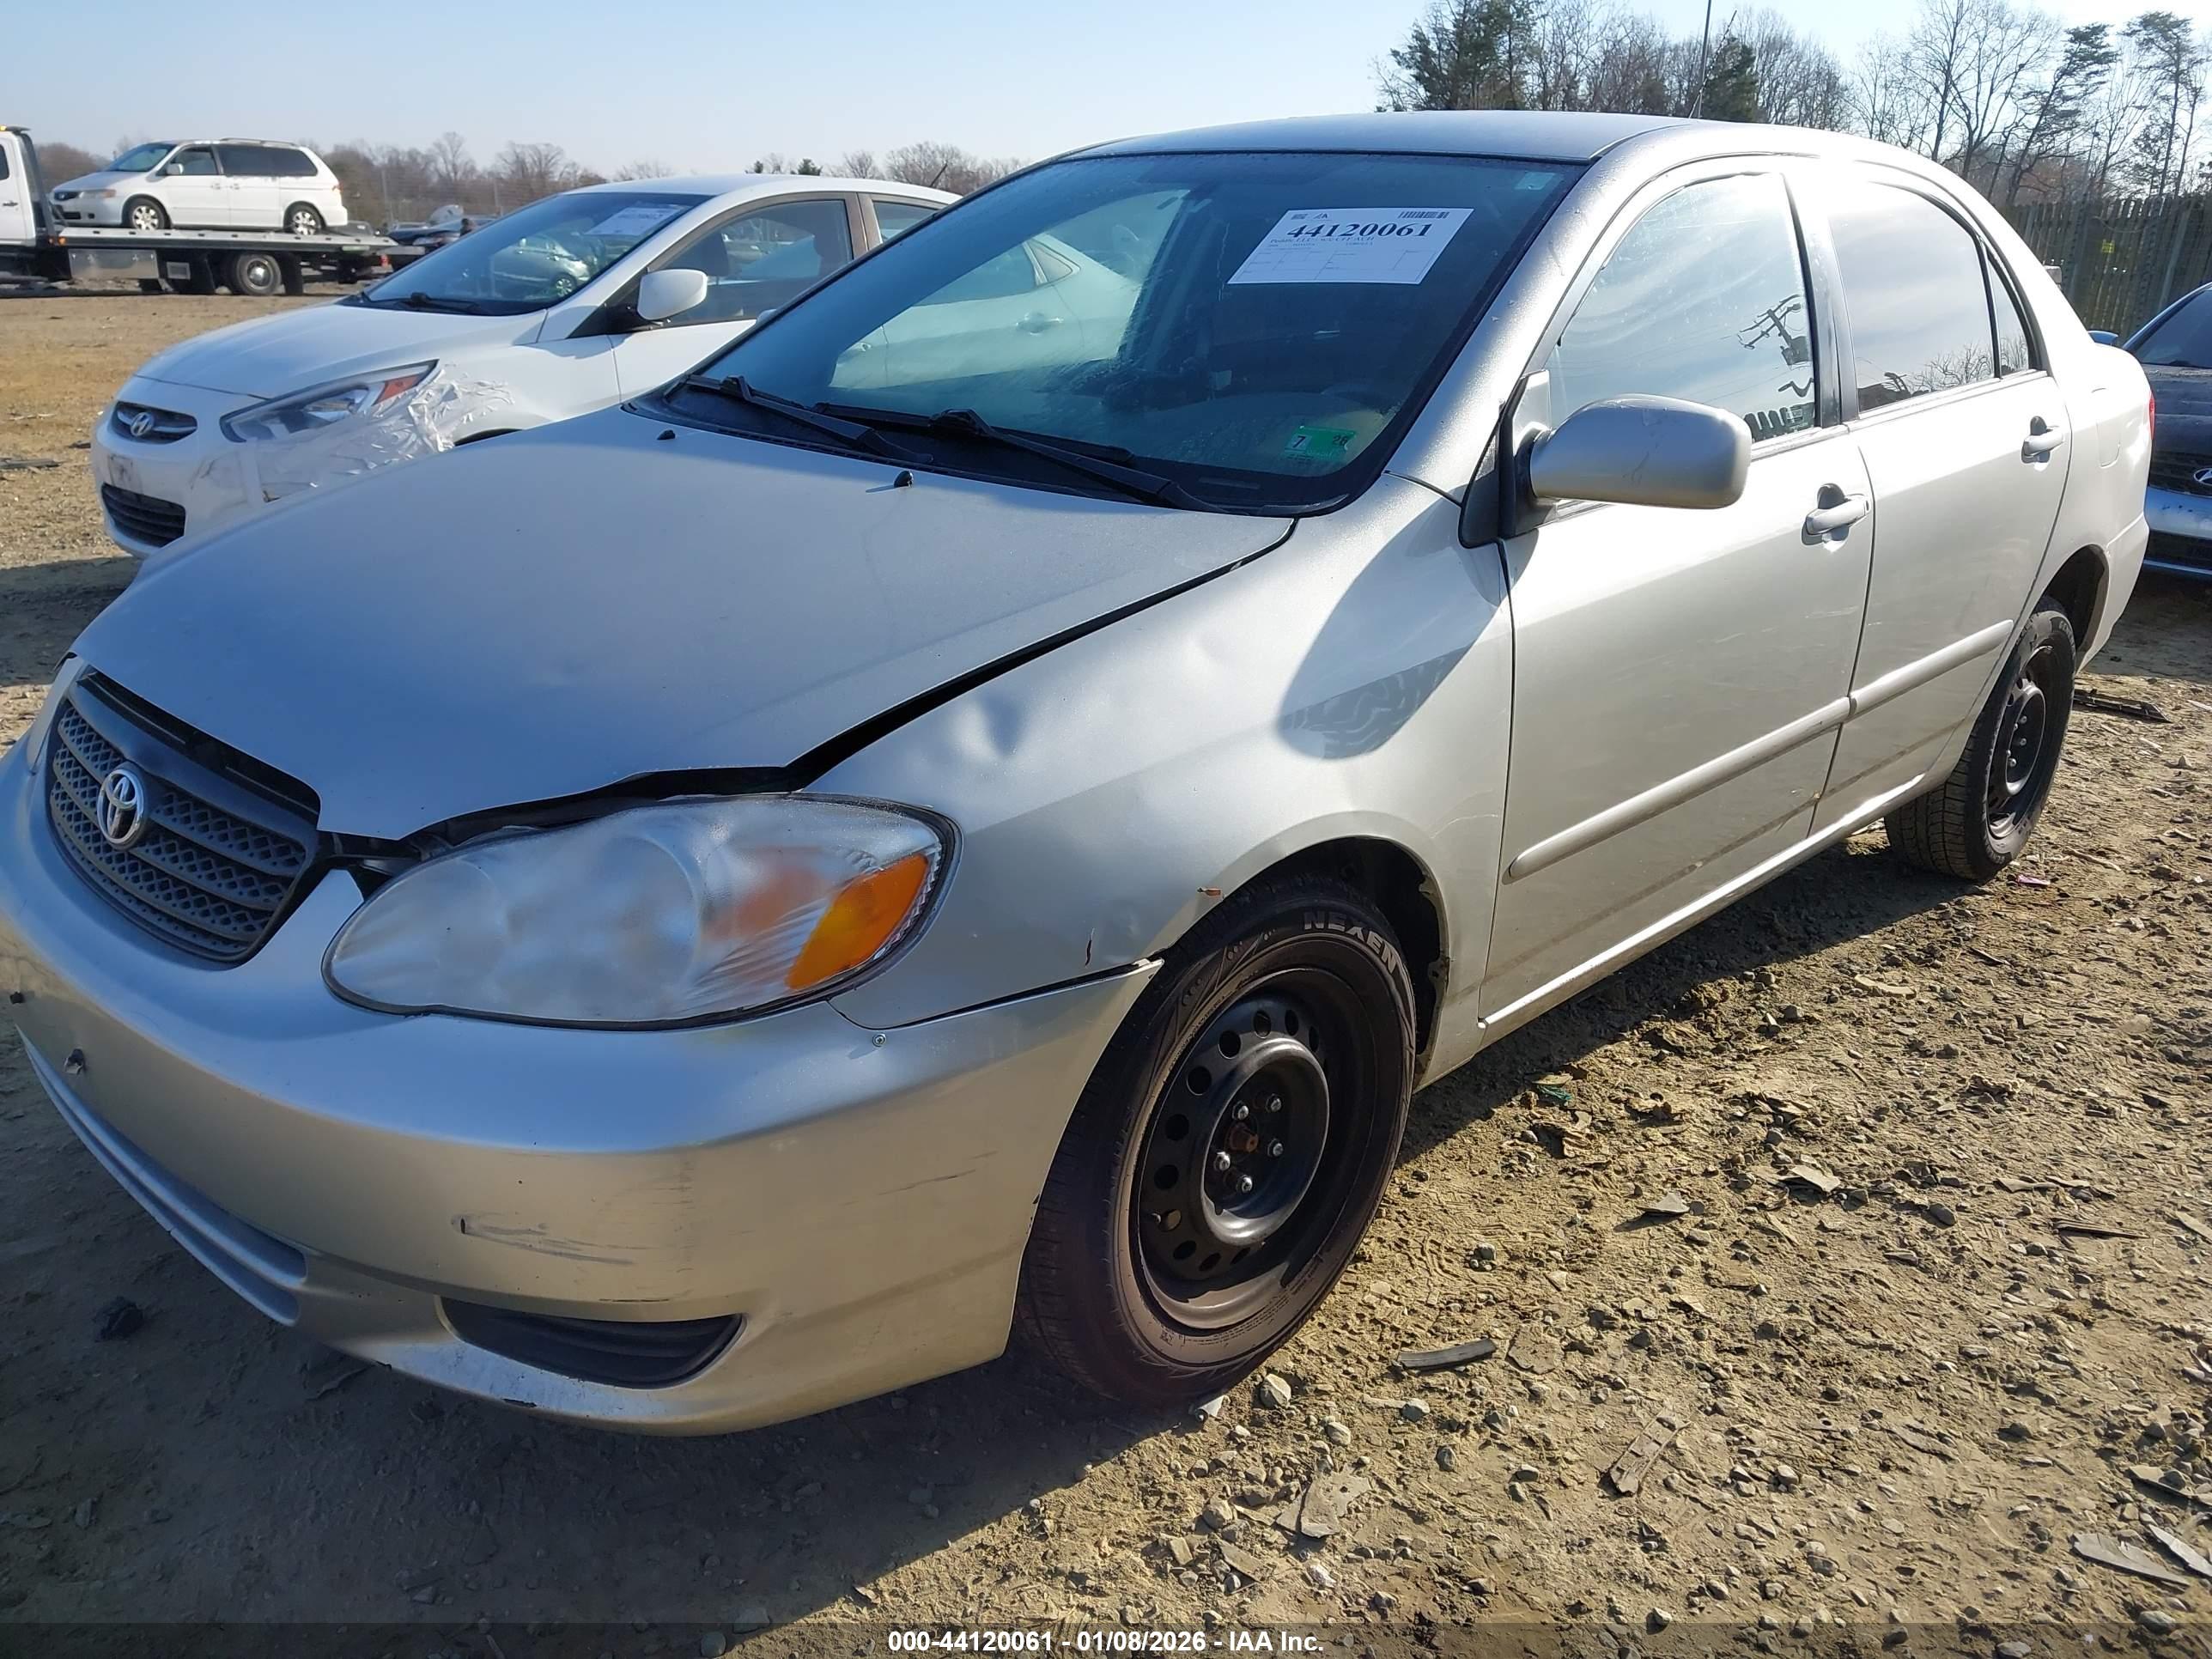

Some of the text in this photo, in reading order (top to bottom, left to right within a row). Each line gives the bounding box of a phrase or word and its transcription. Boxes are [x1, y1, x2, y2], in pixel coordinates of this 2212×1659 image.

[1286, 222, 1433, 238] 44120061
[1291, 434, 1307, 448] 7
[1304, 911, 1400, 975] NEXEN
